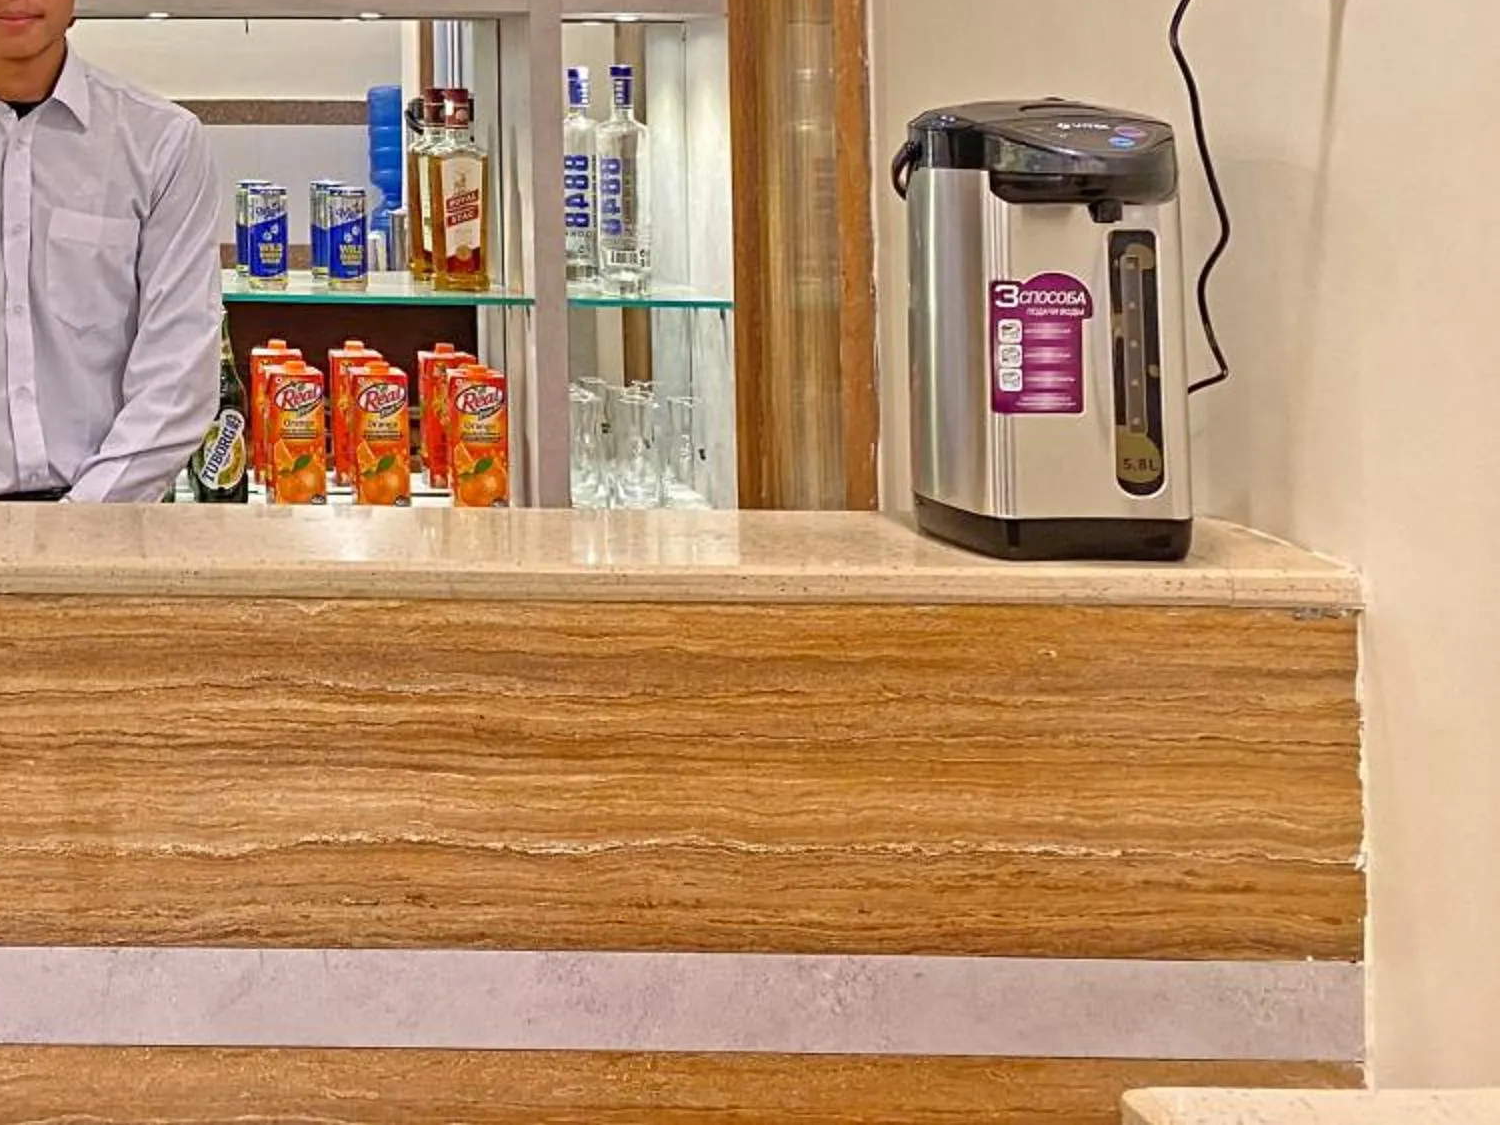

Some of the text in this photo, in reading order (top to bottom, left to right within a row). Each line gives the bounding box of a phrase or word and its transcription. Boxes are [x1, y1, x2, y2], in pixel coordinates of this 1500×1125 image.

[995, 284, 1087, 308] 3 СПОСОБА
[282, 386, 319, 408] Real
[365, 388, 401, 410] Real
[462, 388, 500, 411] Real
[201, 426, 236, 482] TUBORG
